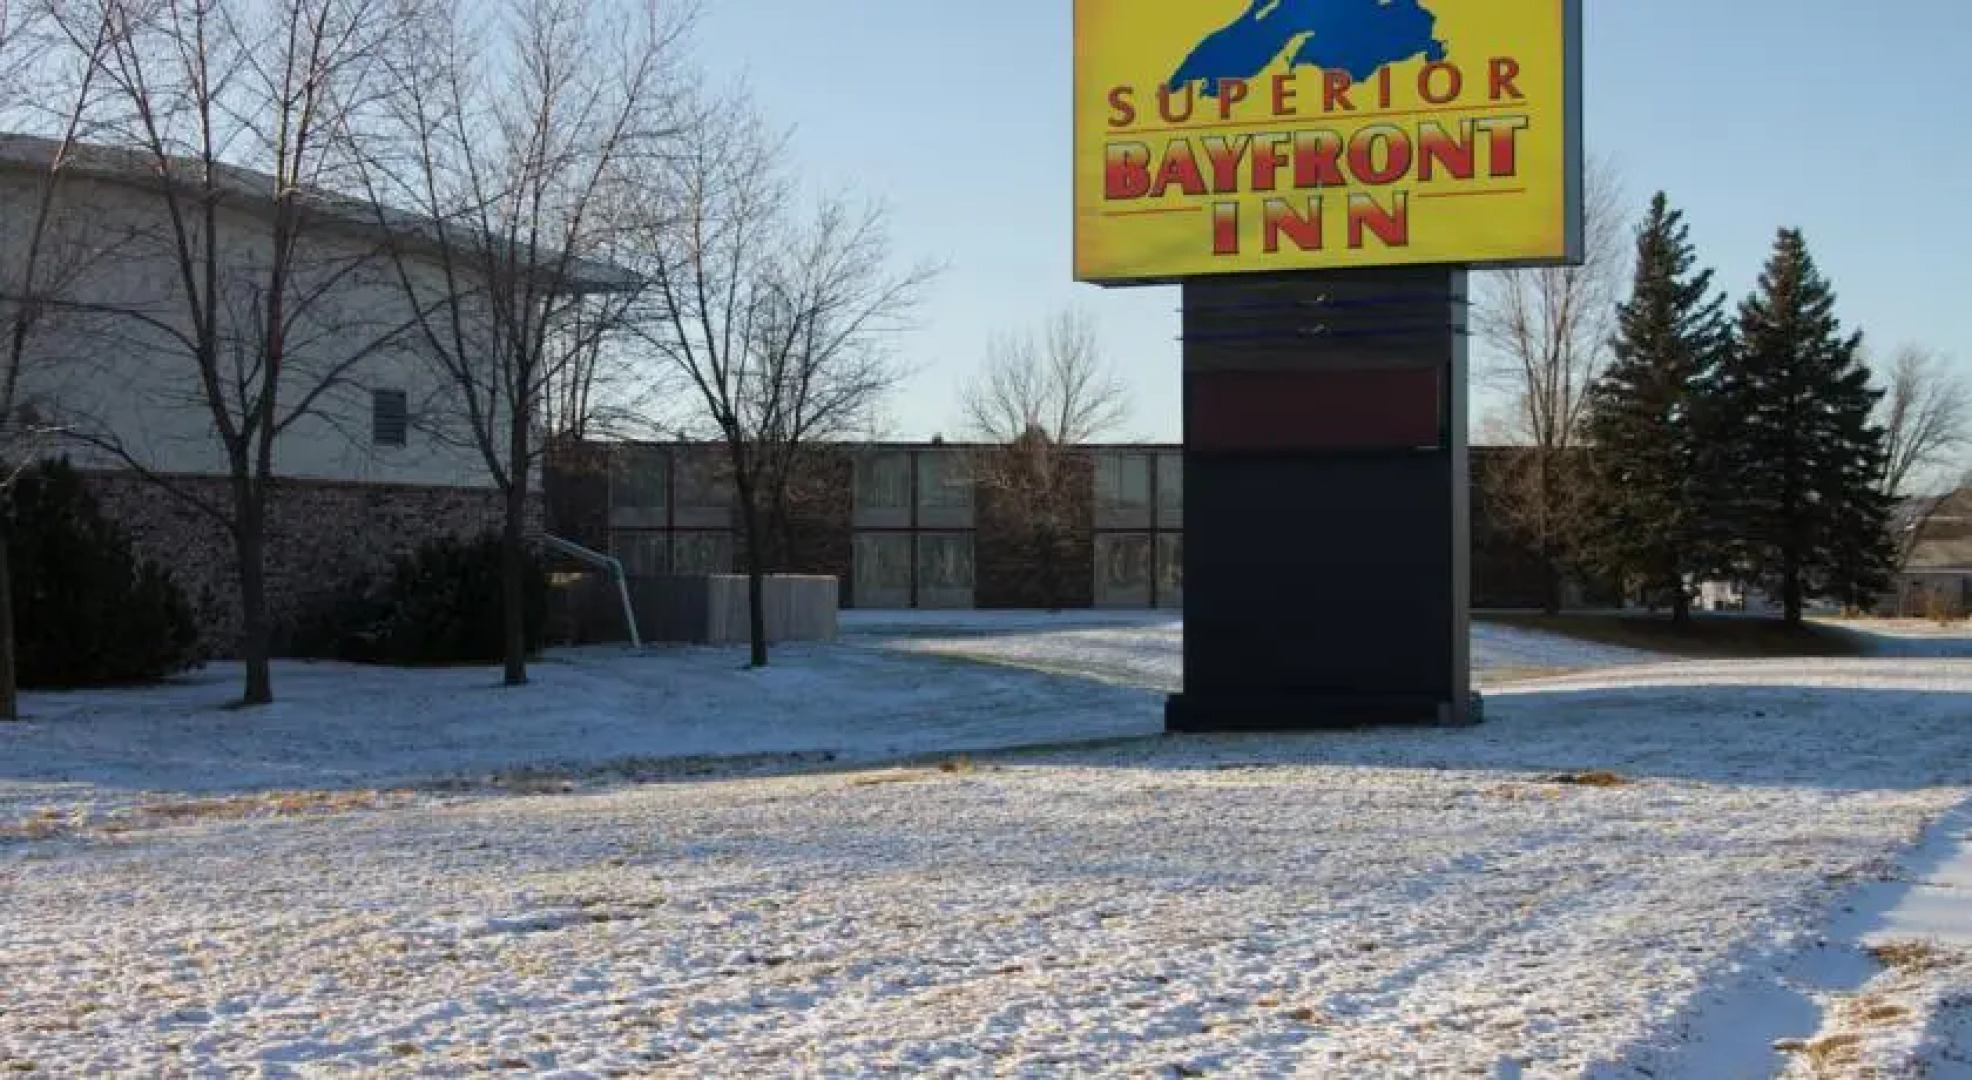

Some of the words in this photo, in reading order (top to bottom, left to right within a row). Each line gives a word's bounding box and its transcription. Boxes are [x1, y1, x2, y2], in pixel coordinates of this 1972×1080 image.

[1108, 57, 1524, 127] SUPERIOR
[1104, 115, 1528, 200] BAYFRONT
[1212, 190, 1409, 255] INN
